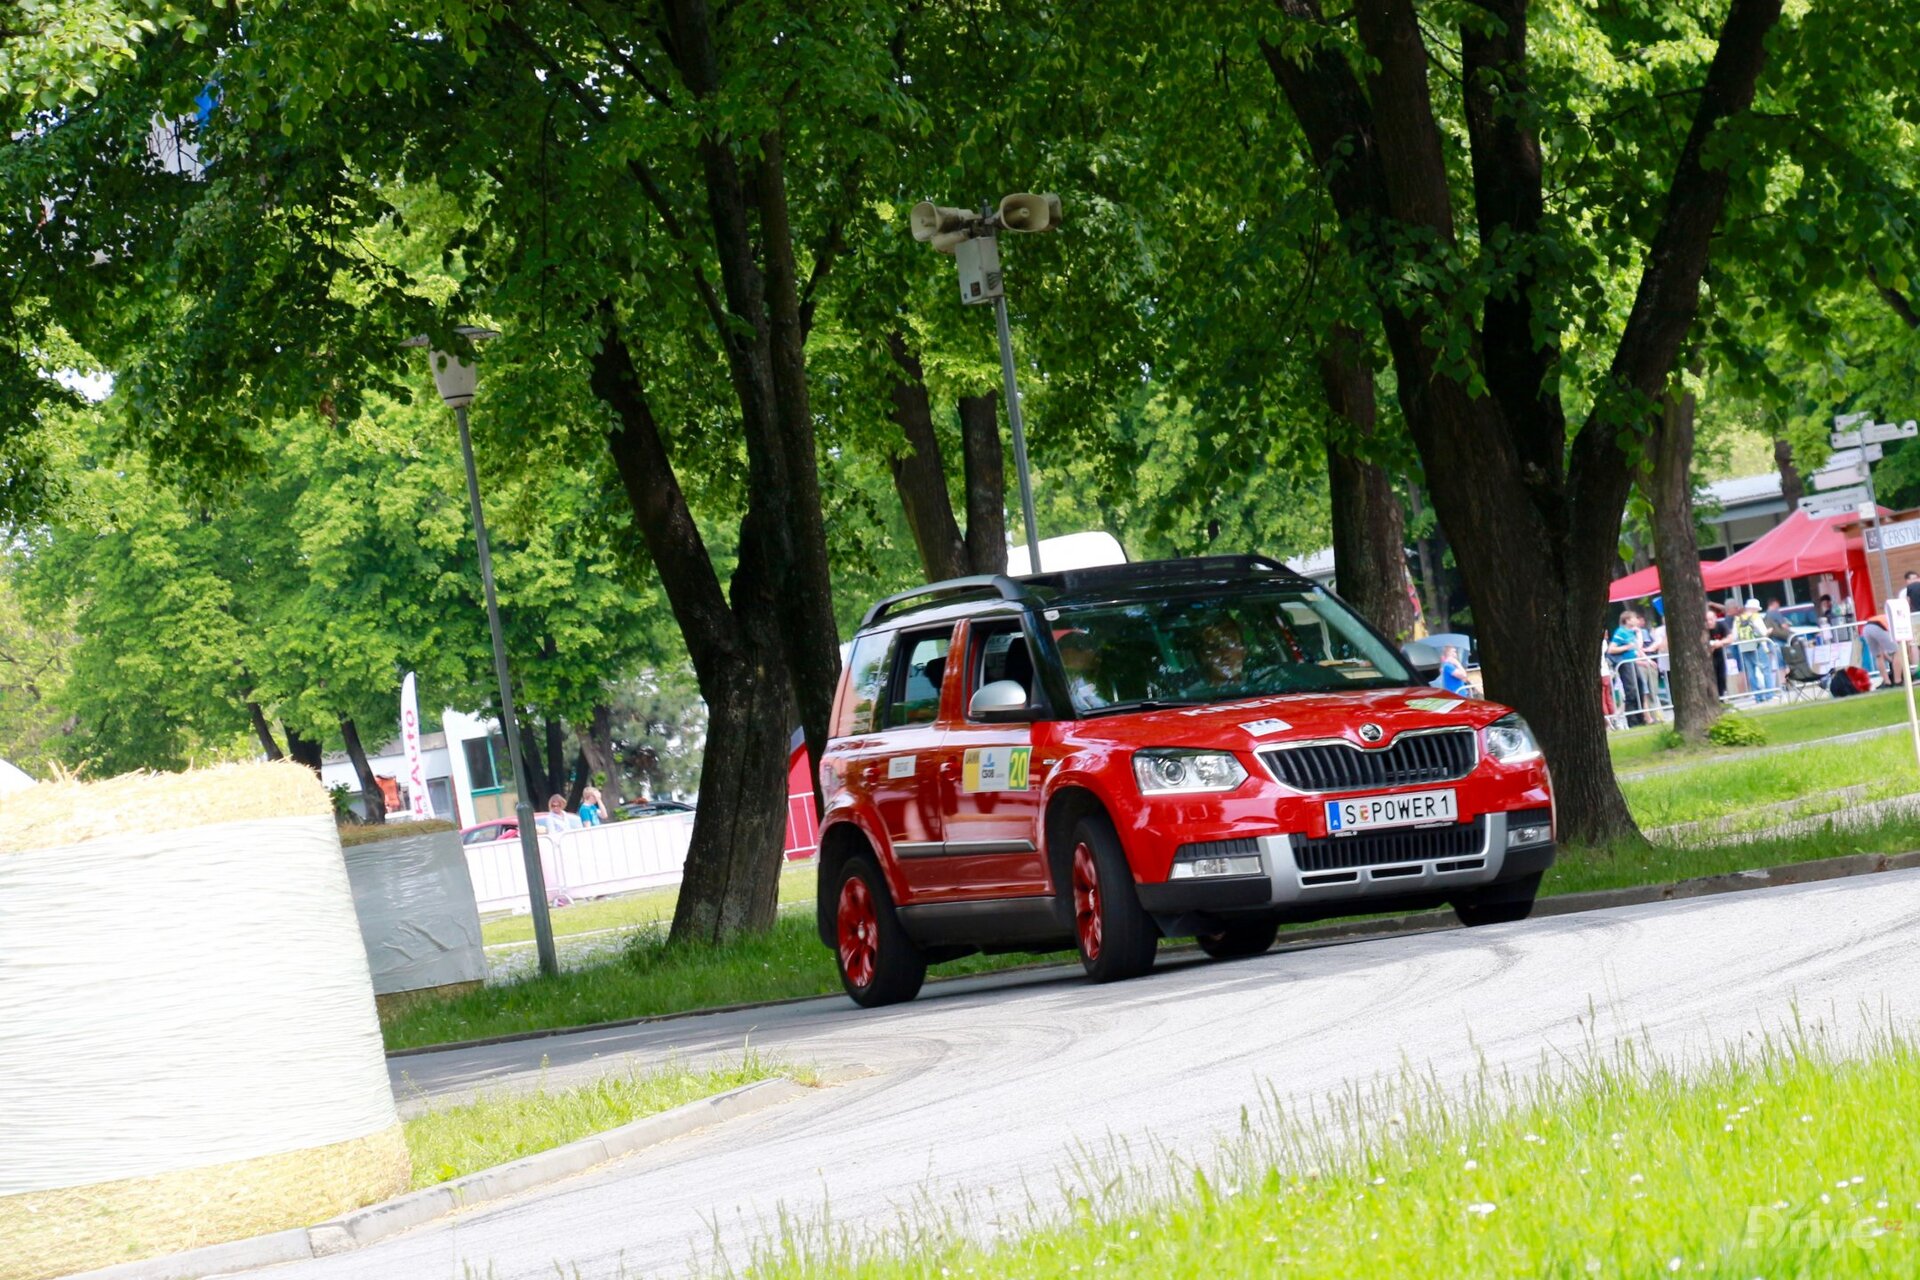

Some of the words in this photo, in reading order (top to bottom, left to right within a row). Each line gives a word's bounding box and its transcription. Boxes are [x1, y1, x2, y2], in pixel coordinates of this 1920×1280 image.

[1009, 751, 1028, 788] 20
[1345, 805, 1357, 825] S
[1372, 796, 1436, 823] POWER
